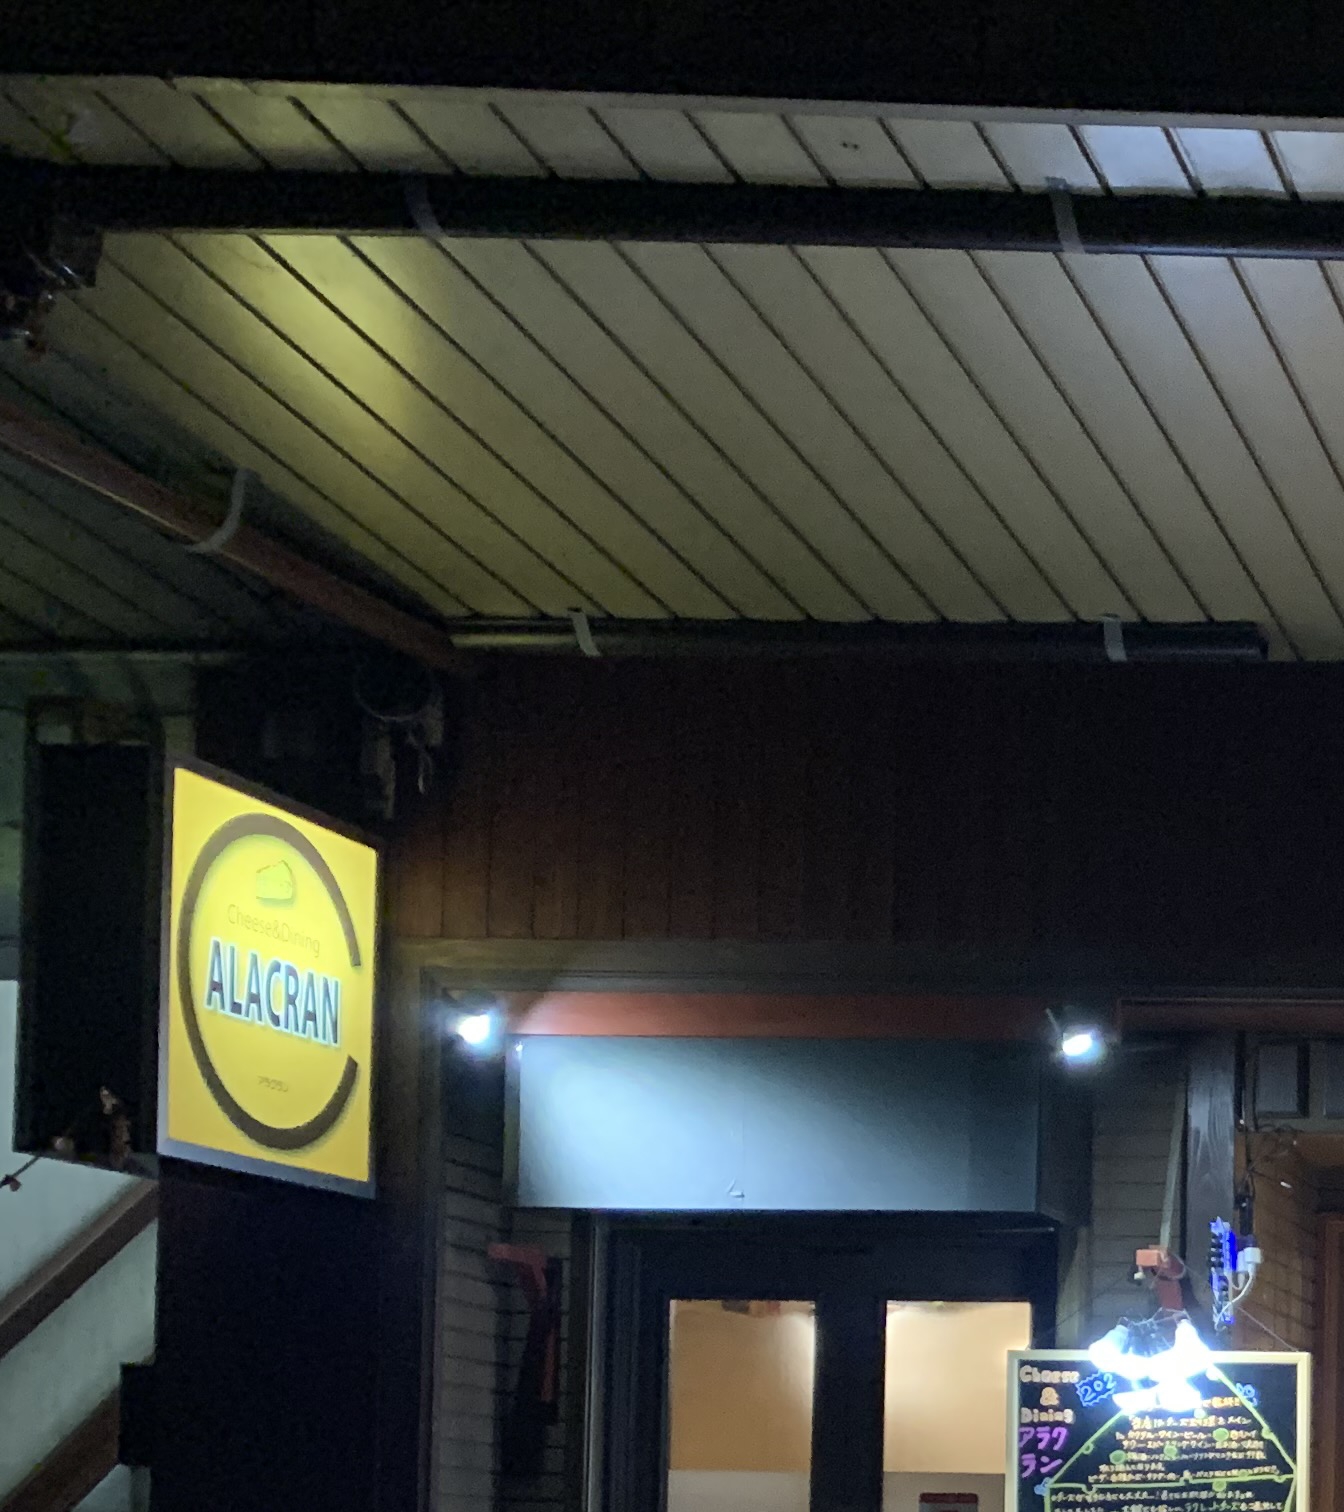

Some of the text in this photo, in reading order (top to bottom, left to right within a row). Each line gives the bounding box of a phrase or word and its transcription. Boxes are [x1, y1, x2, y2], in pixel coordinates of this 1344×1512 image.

[206, 938, 341, 1046] ALACRAN
[1019, 1407, 1075, 1425] Dining
[1018, 1426, 1068, 1451] アラク
[1021, 1452, 1063, 1478] ラン
